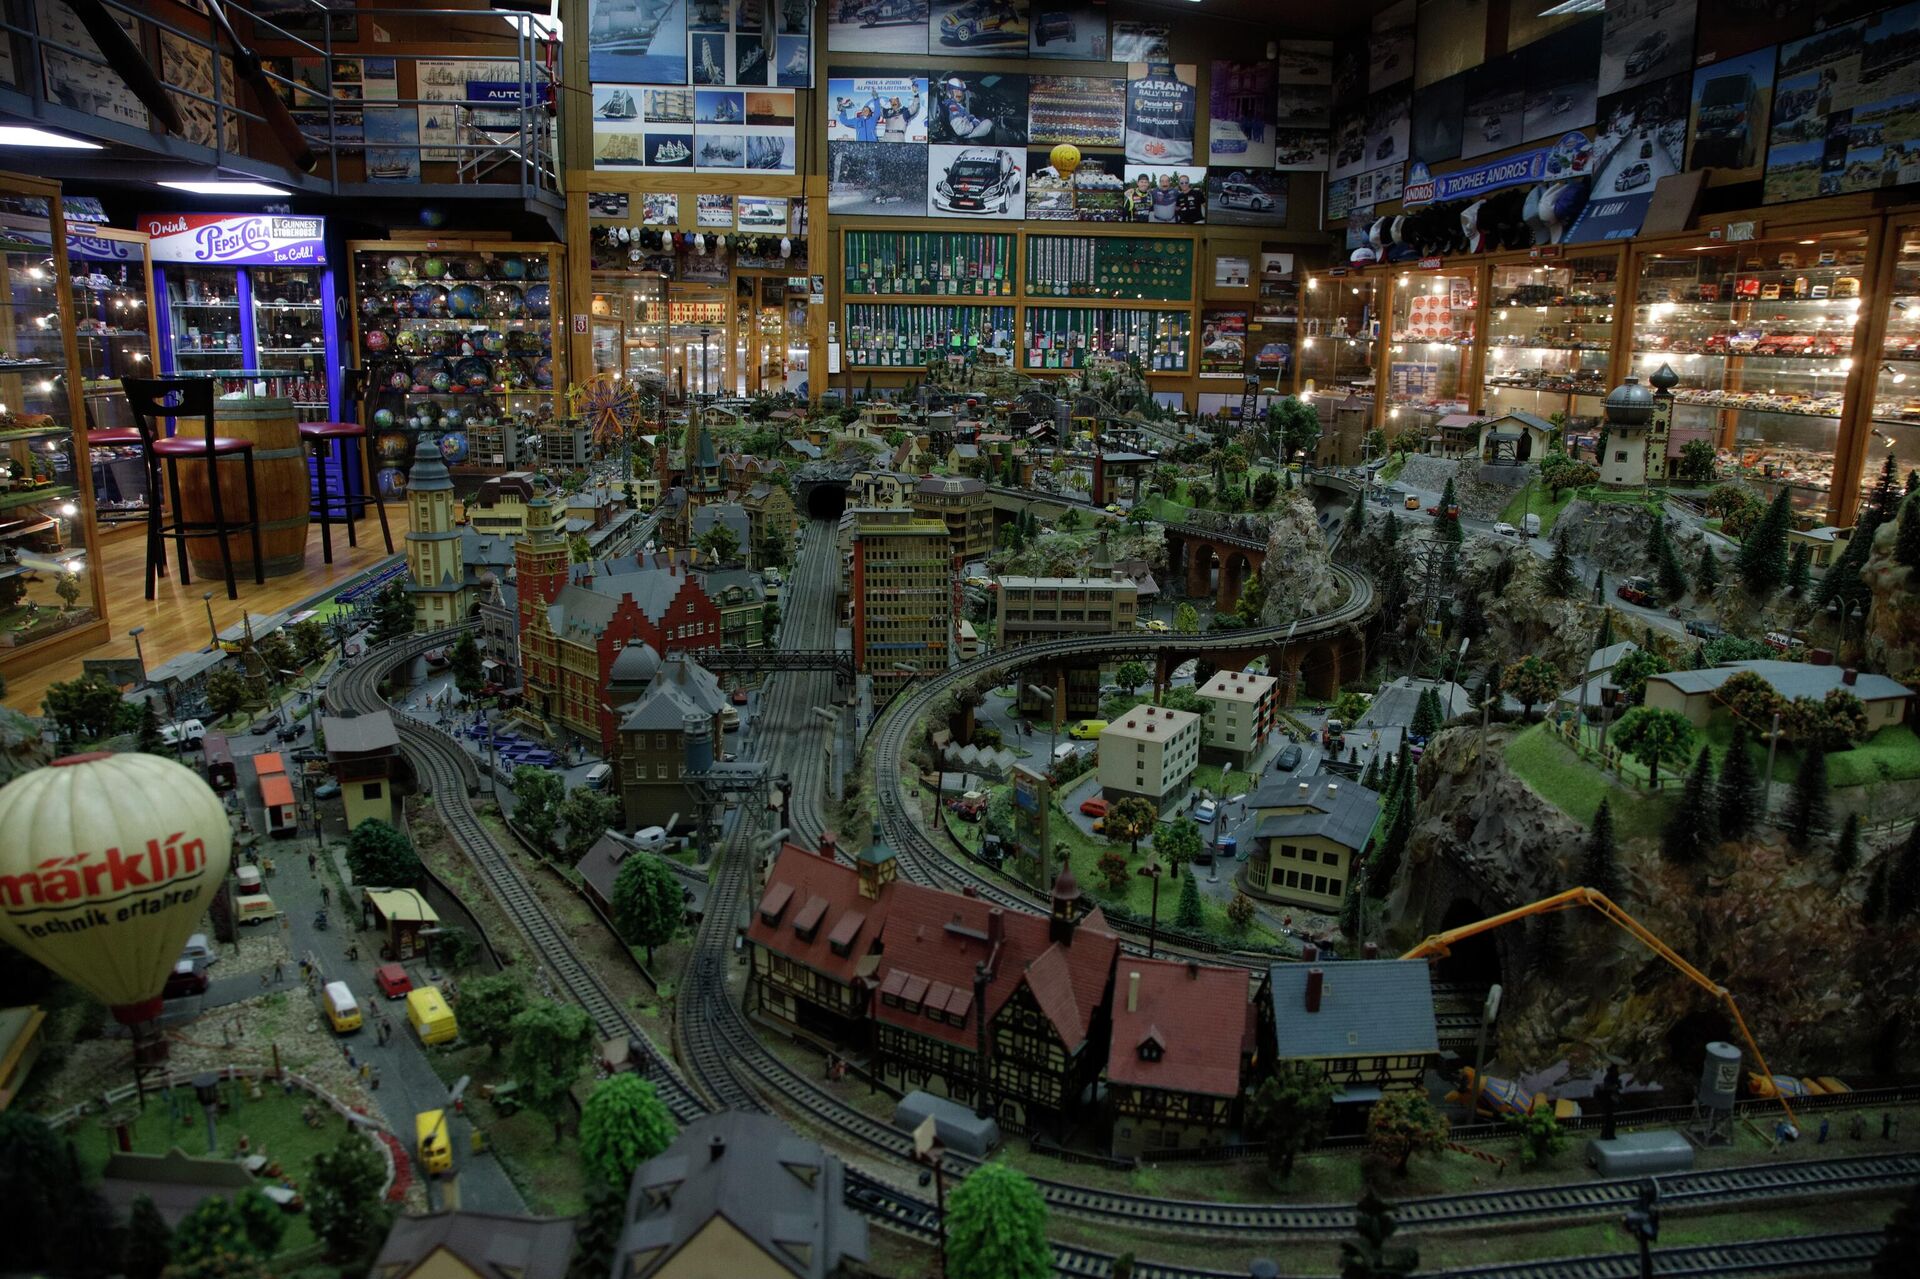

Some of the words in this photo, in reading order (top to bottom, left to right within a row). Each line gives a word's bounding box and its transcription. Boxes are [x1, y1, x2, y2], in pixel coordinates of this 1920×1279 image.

[1134, 80, 1188, 92] KARAM
[1161, 90, 1182, 98] TEAM
[1448, 170, 1485, 193] TROPHEE
[1487, 161, 1528, 183] ANDROS
[1405, 183, 1433, 201] ANDROS
[149, 216, 188, 236] Drink
[281, 219, 317, 229] GUINNESS
[273, 228, 317, 237] STOREHOUSE
[274, 250, 288, 262] Ice
[288, 246, 314, 260] Cold!
[788, 276, 808, 286] EXIT
[0, 832, 206, 906] märklin
[19, 909, 109, 940] Technik
